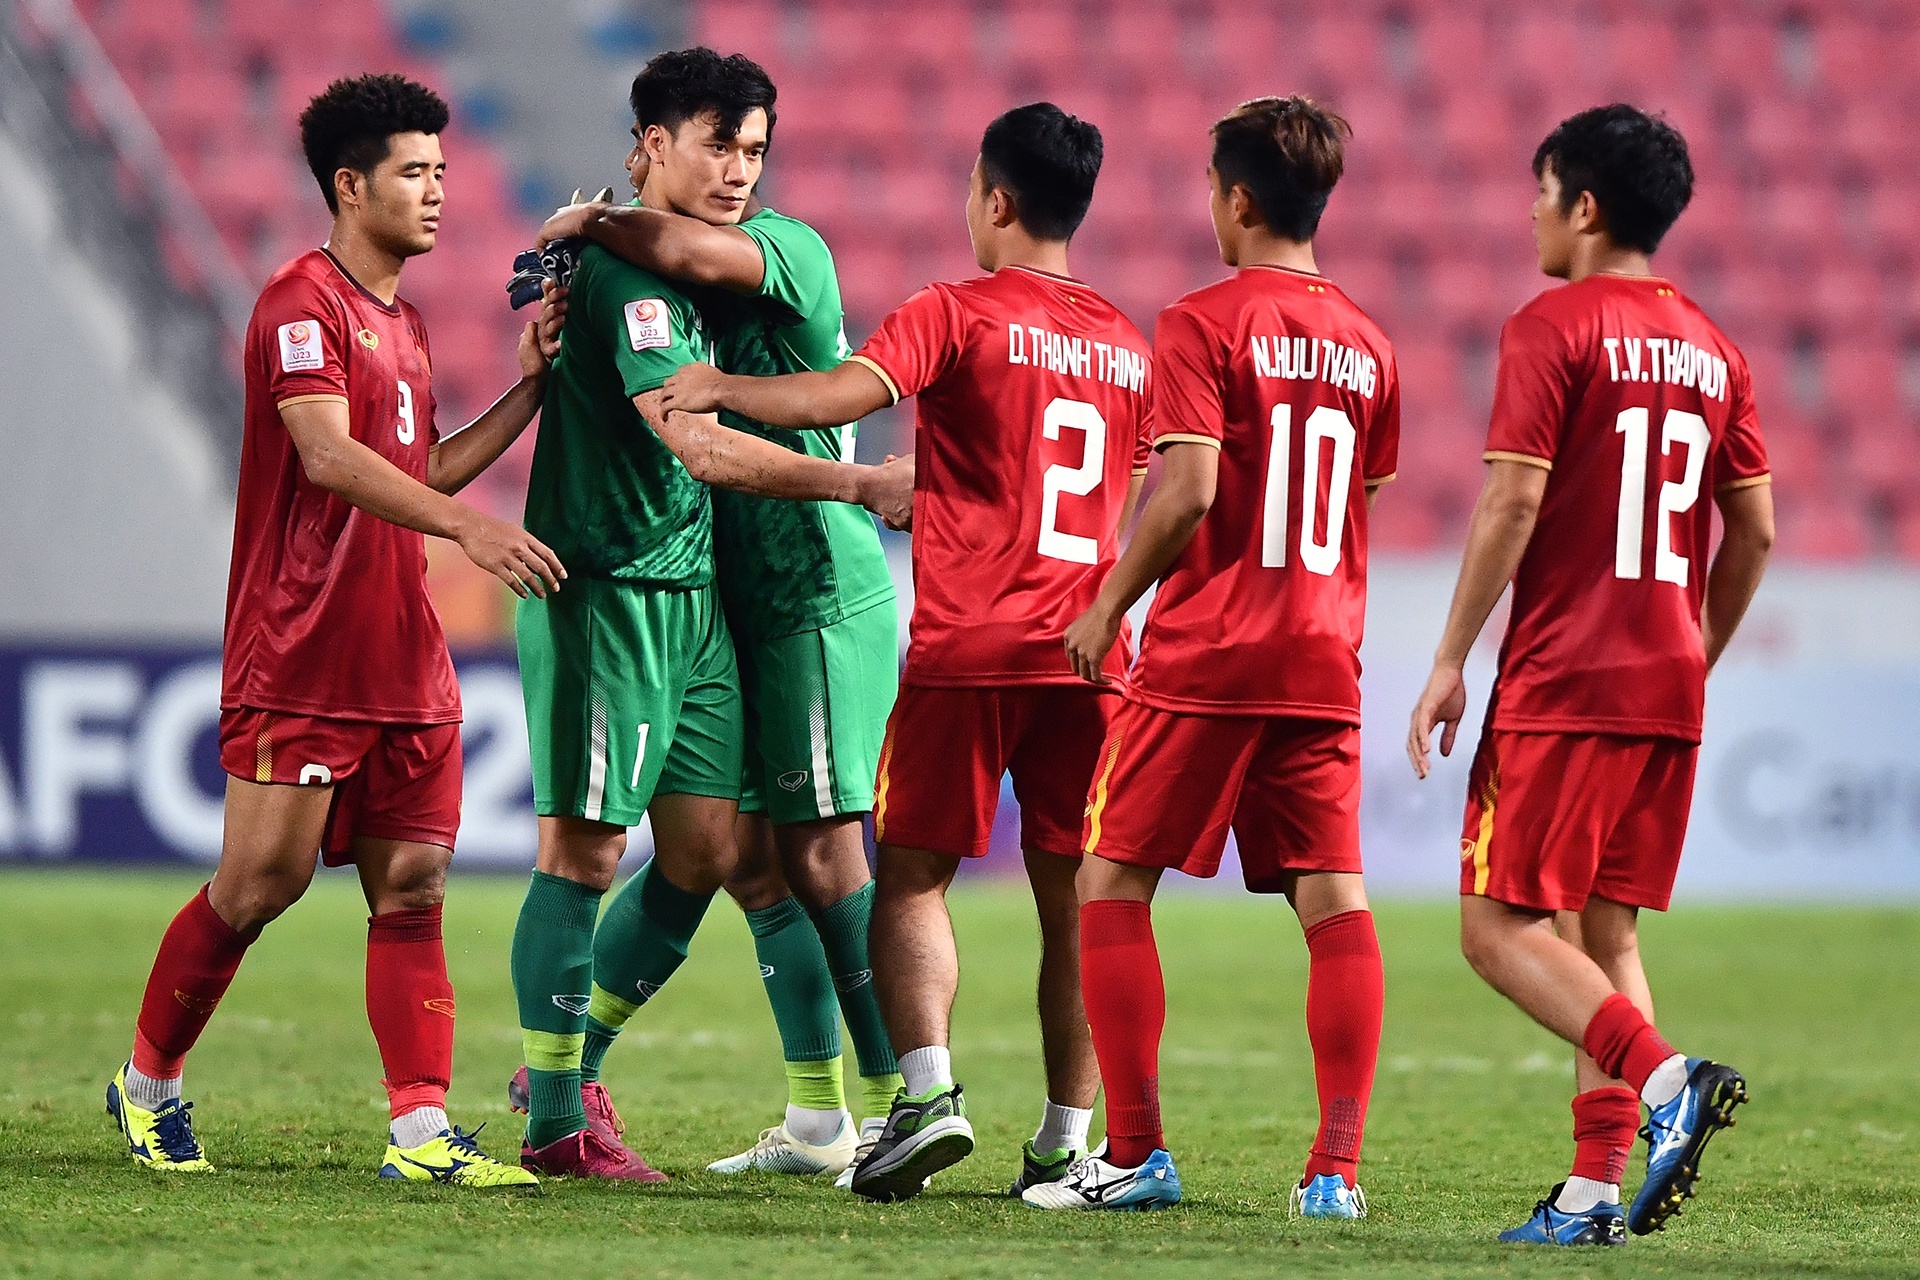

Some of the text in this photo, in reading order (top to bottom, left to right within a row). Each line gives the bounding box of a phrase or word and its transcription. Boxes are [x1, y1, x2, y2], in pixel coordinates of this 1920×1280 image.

[292, 351, 311, 360] U23
[640, 328, 658, 337] U23
[1008, 323, 1146, 396] D.THANH THINH
[1251, 335, 1319, 380] N.HUU
[396, 379, 416, 446] 9
[1037, 397, 1106, 565] 2
[1262, 402, 1356, 577] 10
[1615, 406, 1711, 588] 12
[0, 658, 223, 865] FC
[631, 722, 650, 788] 1
[1713, 726, 1920, 853] Car
